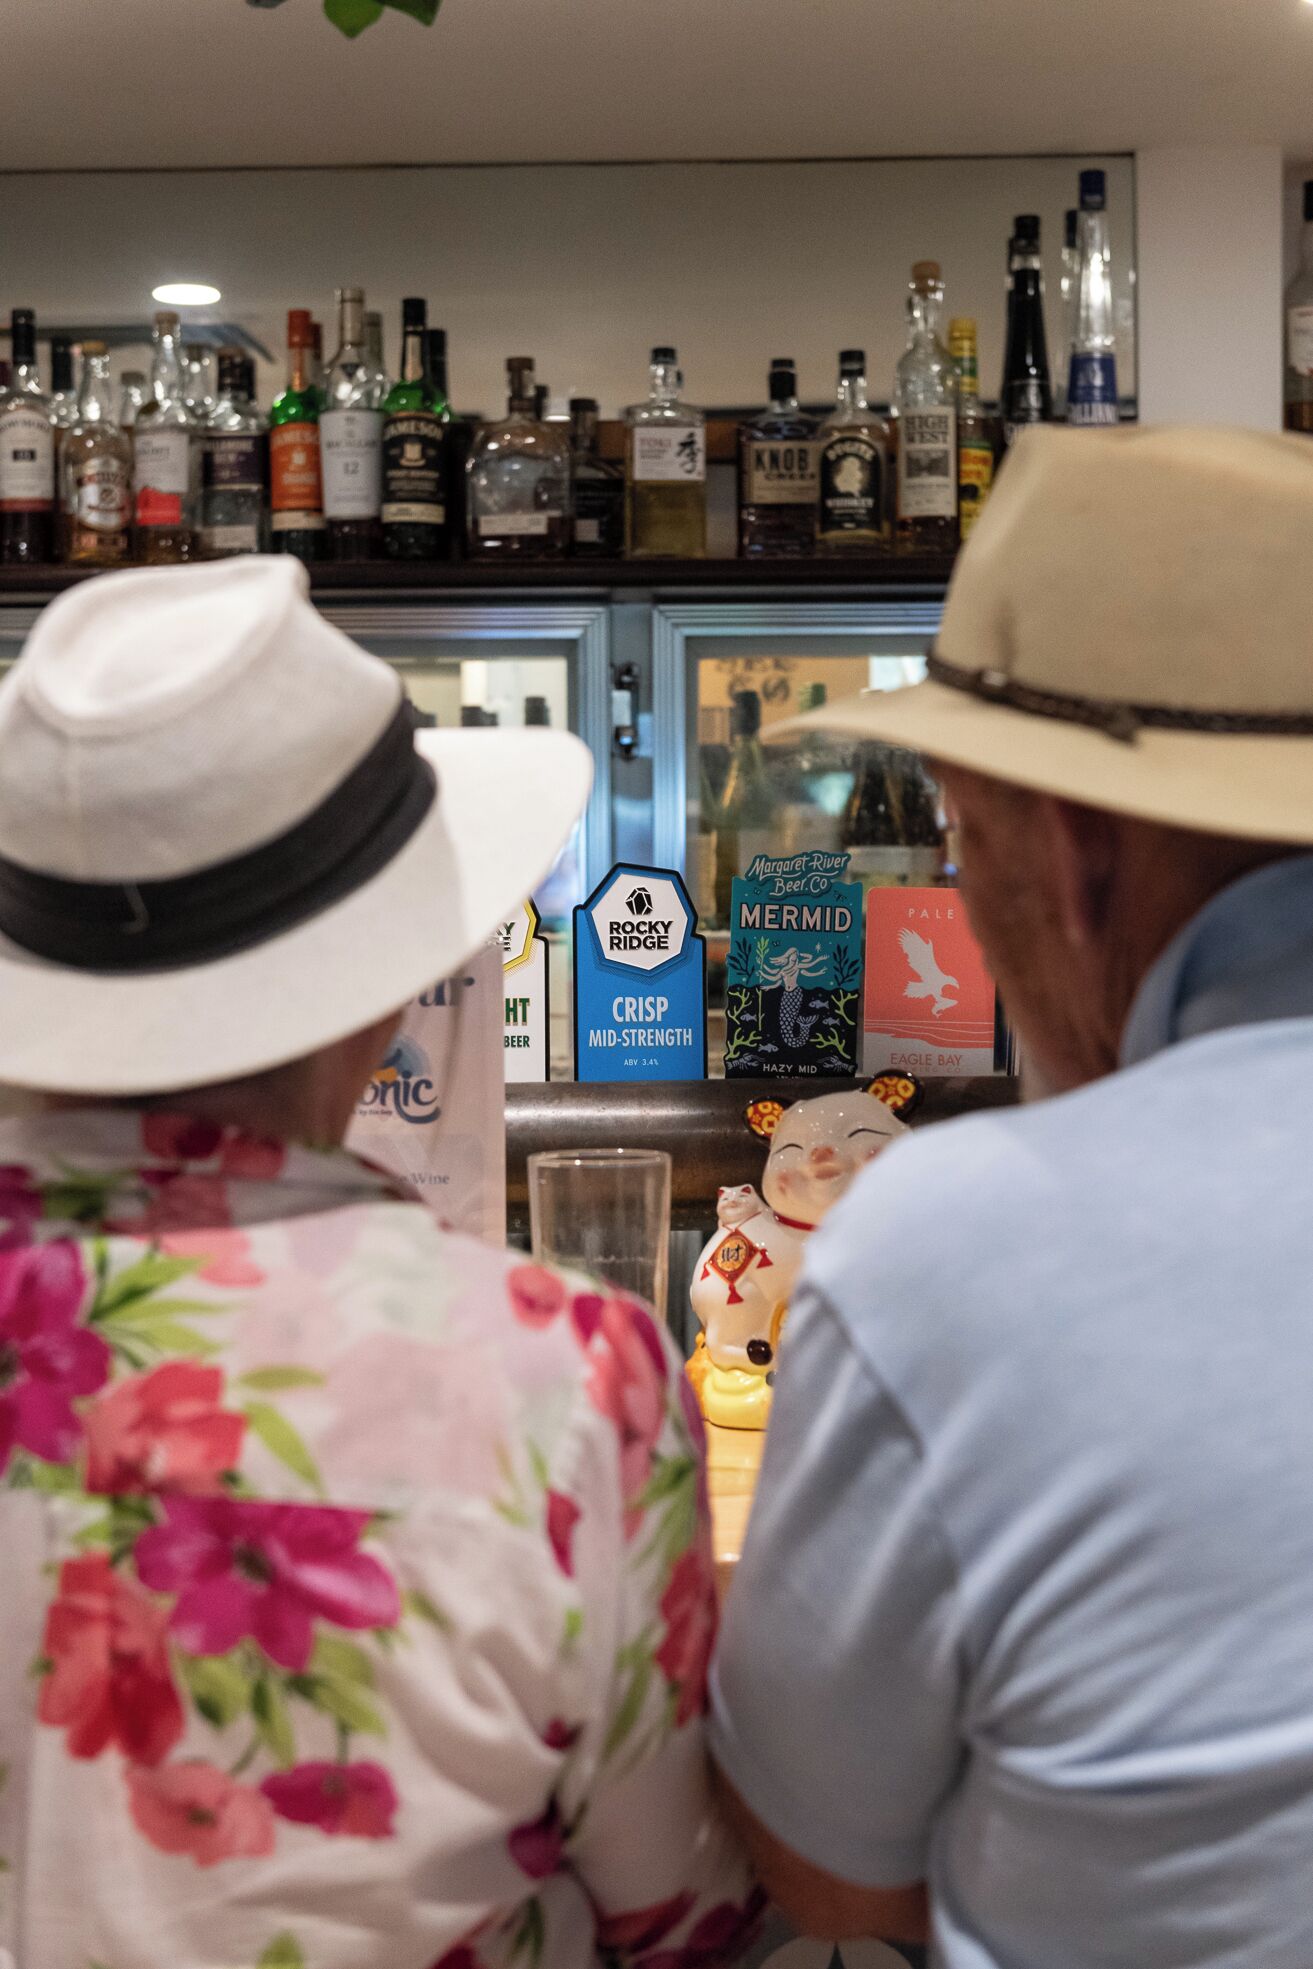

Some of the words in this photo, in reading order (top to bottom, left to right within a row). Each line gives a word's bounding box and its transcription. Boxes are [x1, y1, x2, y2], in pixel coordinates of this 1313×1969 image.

[755, 448, 808, 471] KNOB
[748, 855, 810, 880] Margaret
[808, 853, 848, 871] River
[739, 903, 853, 932] MERMID
[908, 908, 954, 919] PALE
[609, 920, 673, 935] ROCKY
[609, 935, 669, 950] RIDGE
[612, 996, 669, 1023] CRISP
[504, 1035, 530, 1048] BEER
[589, 1028, 693, 1047] MID-STRENGTH
[624, 1058, 638, 1066] ABV
[890, 1053, 933, 1066] EAGLE
[938, 1054, 962, 1067] BAY
[763, 1063, 793, 1073] HAZY
[798, 1064, 818, 1074] MID
[360, 1070, 441, 1124] onic
